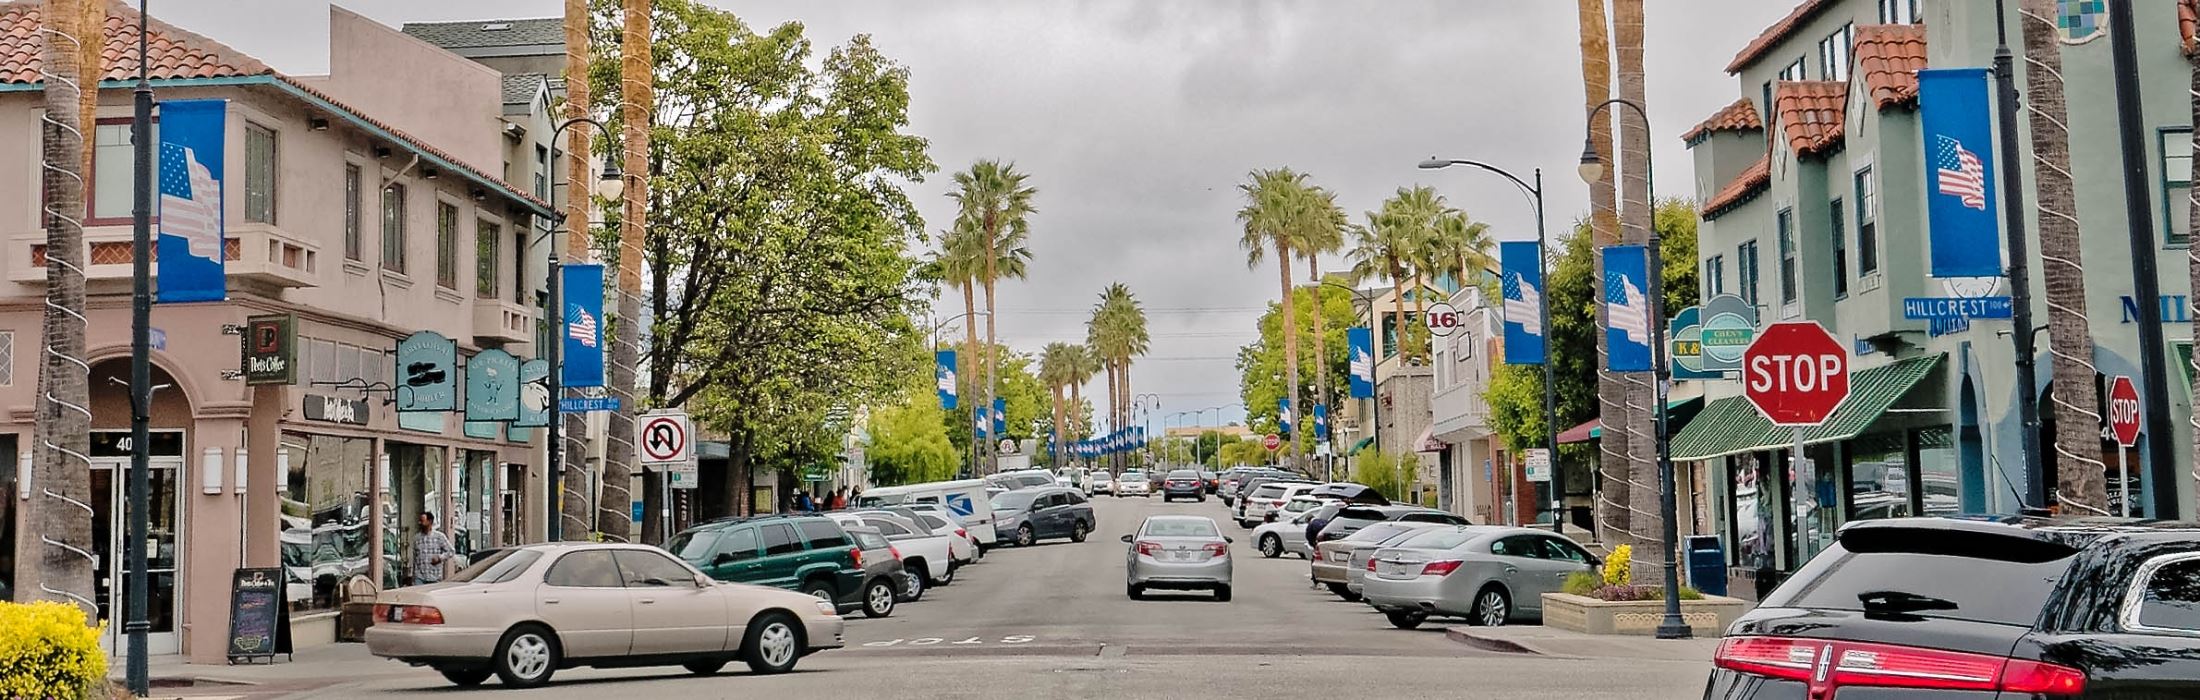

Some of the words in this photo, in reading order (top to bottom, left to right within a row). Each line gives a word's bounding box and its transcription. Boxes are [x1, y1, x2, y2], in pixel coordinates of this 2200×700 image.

[1906, 299, 1988, 316] HILLCREST
[1429, 312, 1457, 328] 16
[1678, 342, 1688, 355] K
[1690, 342, 1700, 354] &
[1751, 354, 1842, 393] STOP
[561, 400, 603, 410] HILLCREST
[2113, 398, 2138, 425] STOP
[862, 634, 1036, 647] STOP
